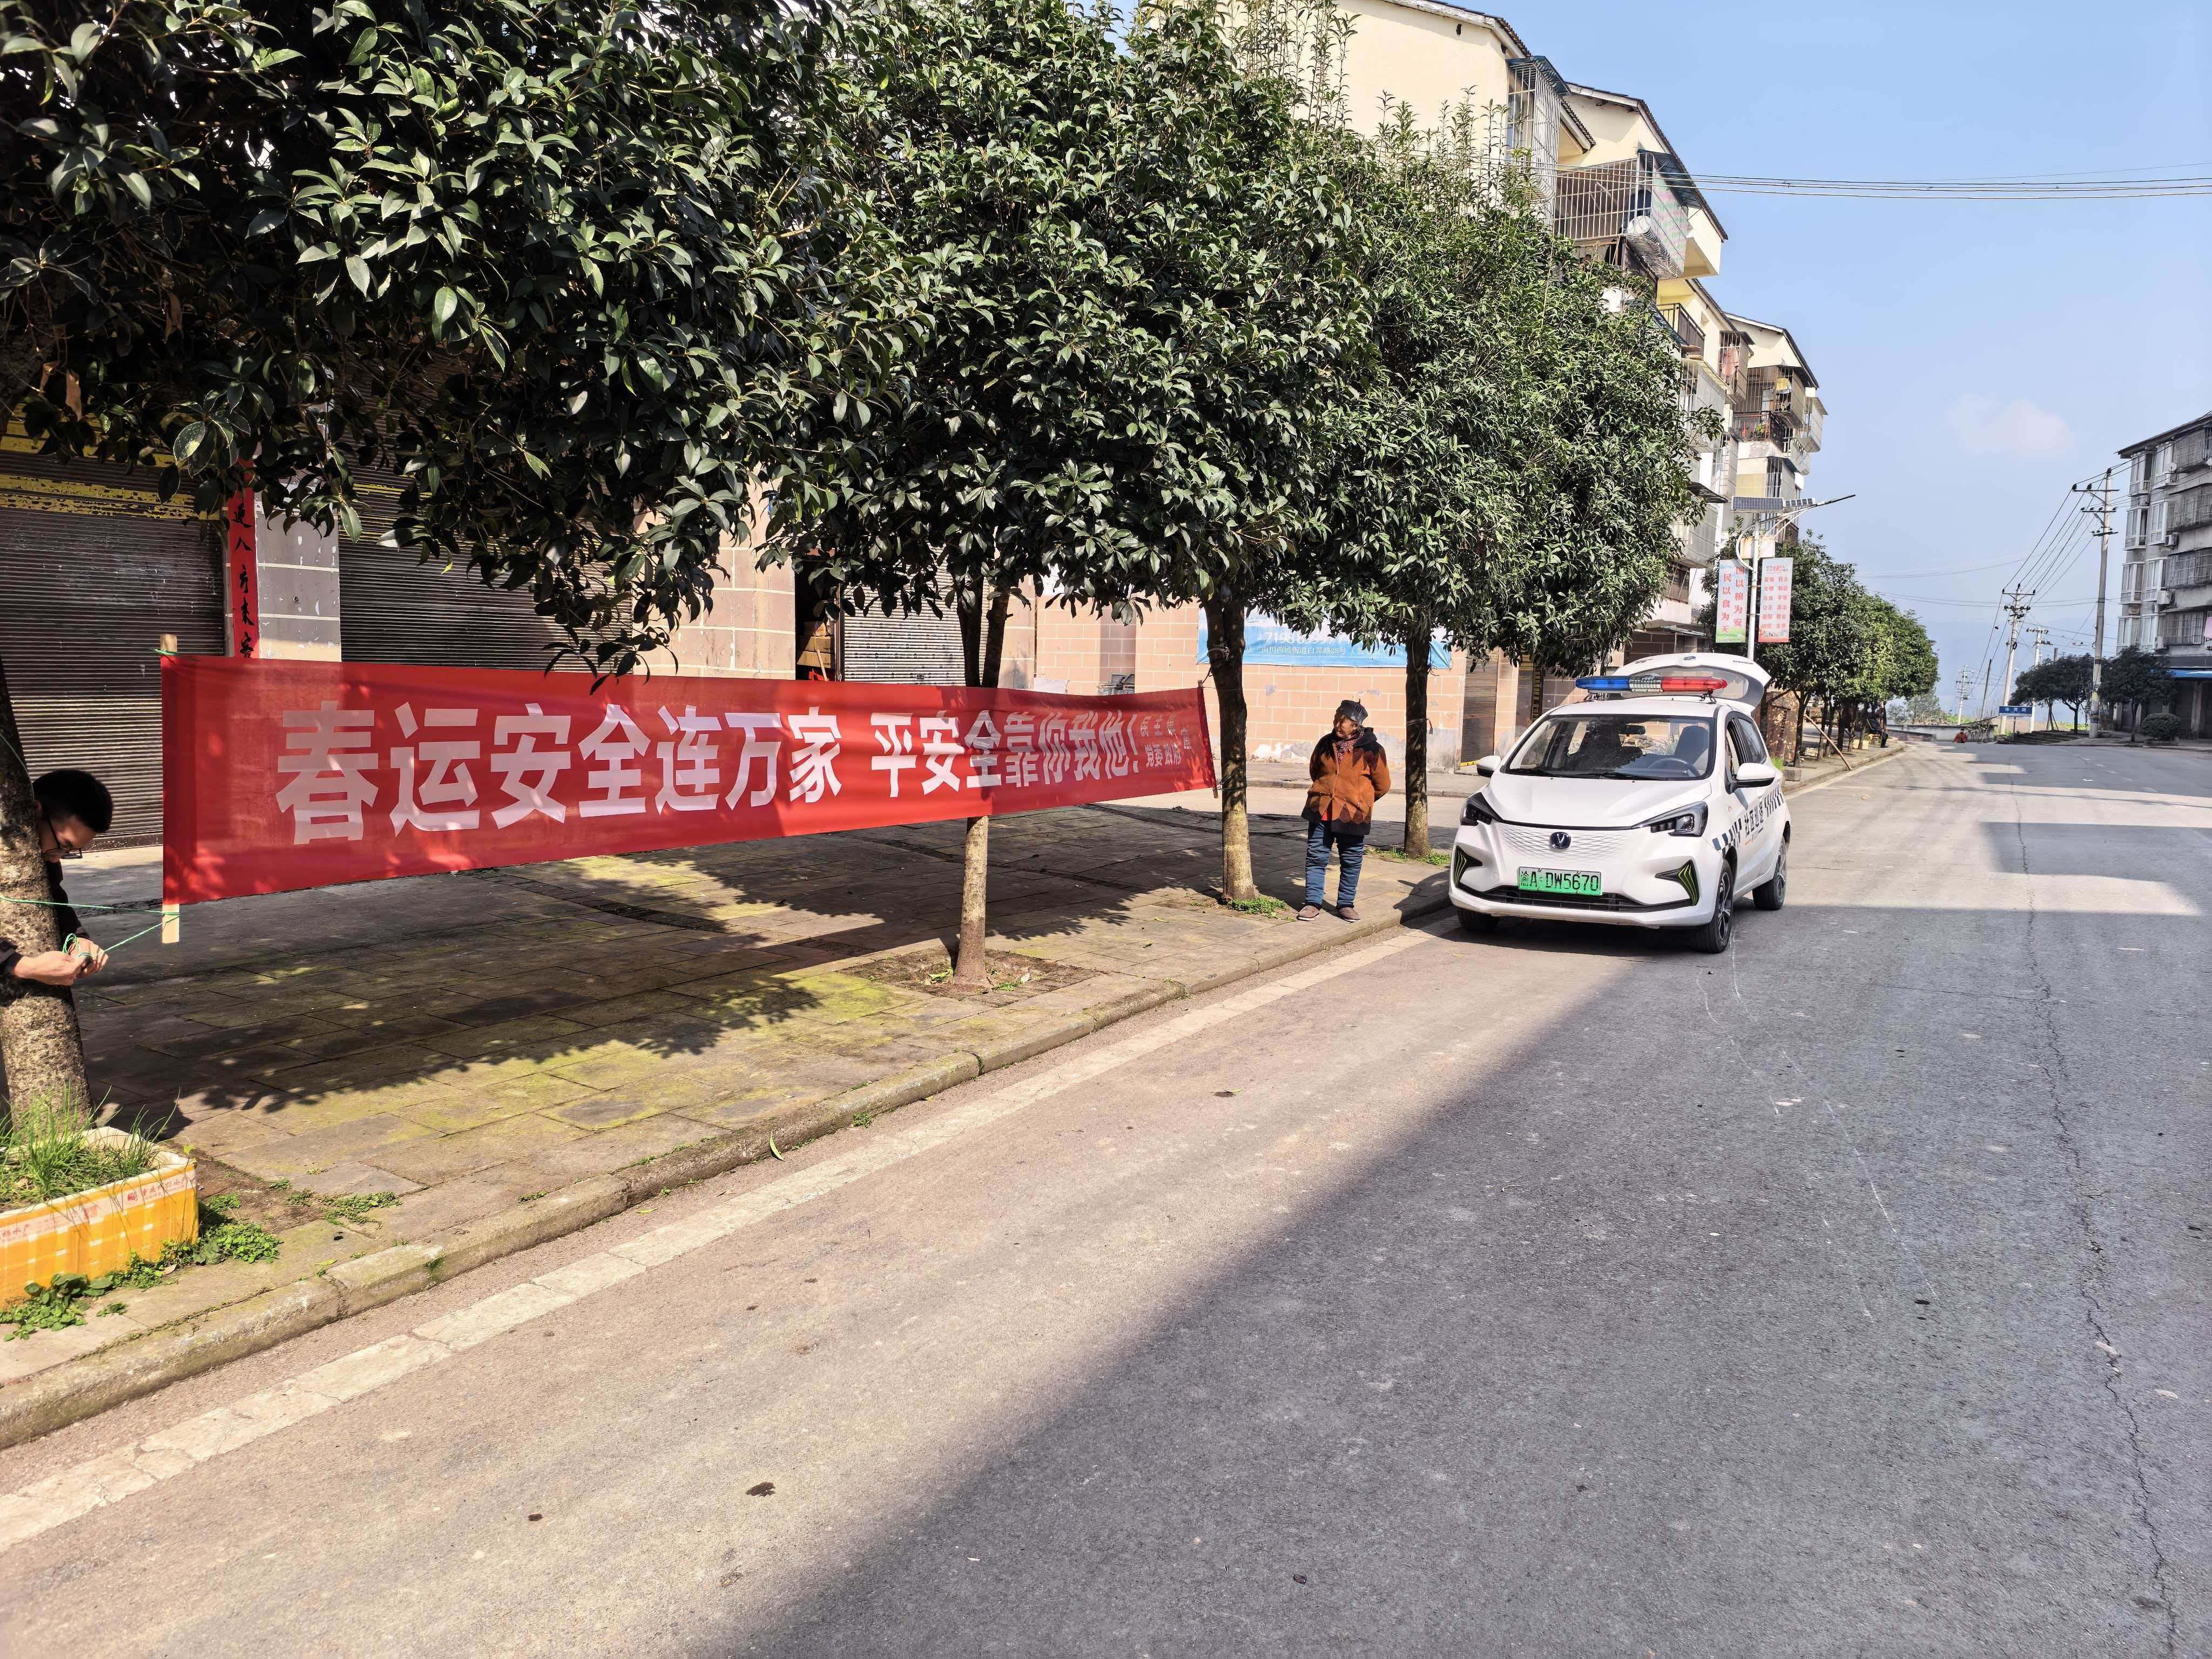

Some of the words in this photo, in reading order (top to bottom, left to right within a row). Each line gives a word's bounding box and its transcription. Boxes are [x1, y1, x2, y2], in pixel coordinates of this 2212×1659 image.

[1721, 574, 1732, 633] 民以食为天
[276, 700, 842, 845] 春运安全连万家
[1144, 742, 1181, 767] 党委政府
